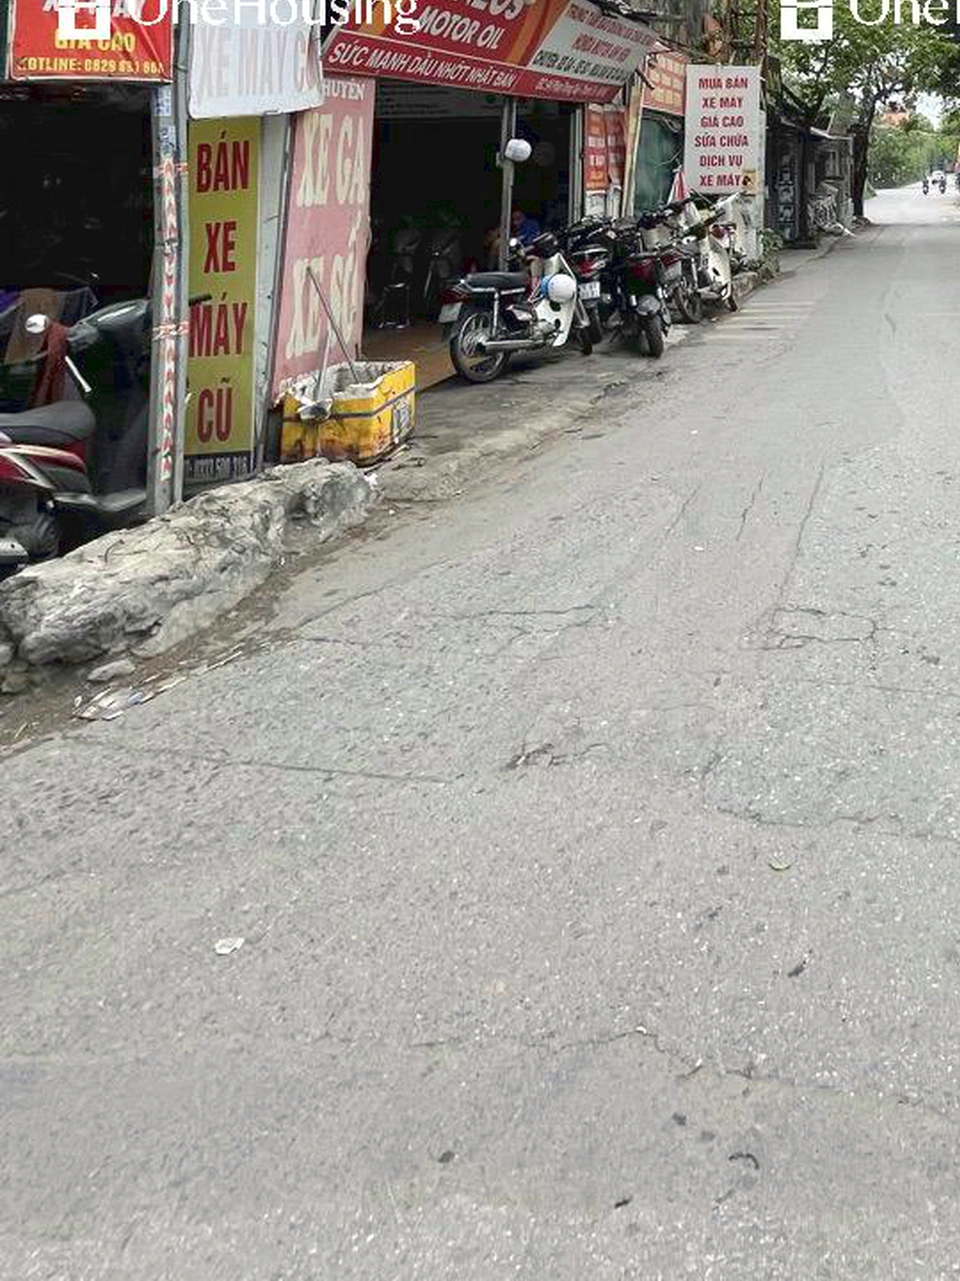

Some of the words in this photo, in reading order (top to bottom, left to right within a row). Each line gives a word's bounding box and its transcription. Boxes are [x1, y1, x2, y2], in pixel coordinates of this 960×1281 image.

[417, 5, 479, 45] MOTOR
[477, 23, 506, 50] OIL
[328, 39, 368, 66] SỨC
[322, 77, 365, 102] HUYÊN
[698, 78, 723, 89] MUA
[702, 97, 716, 109] XE
[721, 115, 745, 128] CAO
[196, 130, 251, 194] BÁN
[297, 112, 333, 208] XE
[699, 174, 714, 187] XE
[204, 221, 237, 274] XE
[189, 293, 248, 359] MÁY
[284, 256, 324, 360] XE
[198, 378, 233, 444] CŨ
